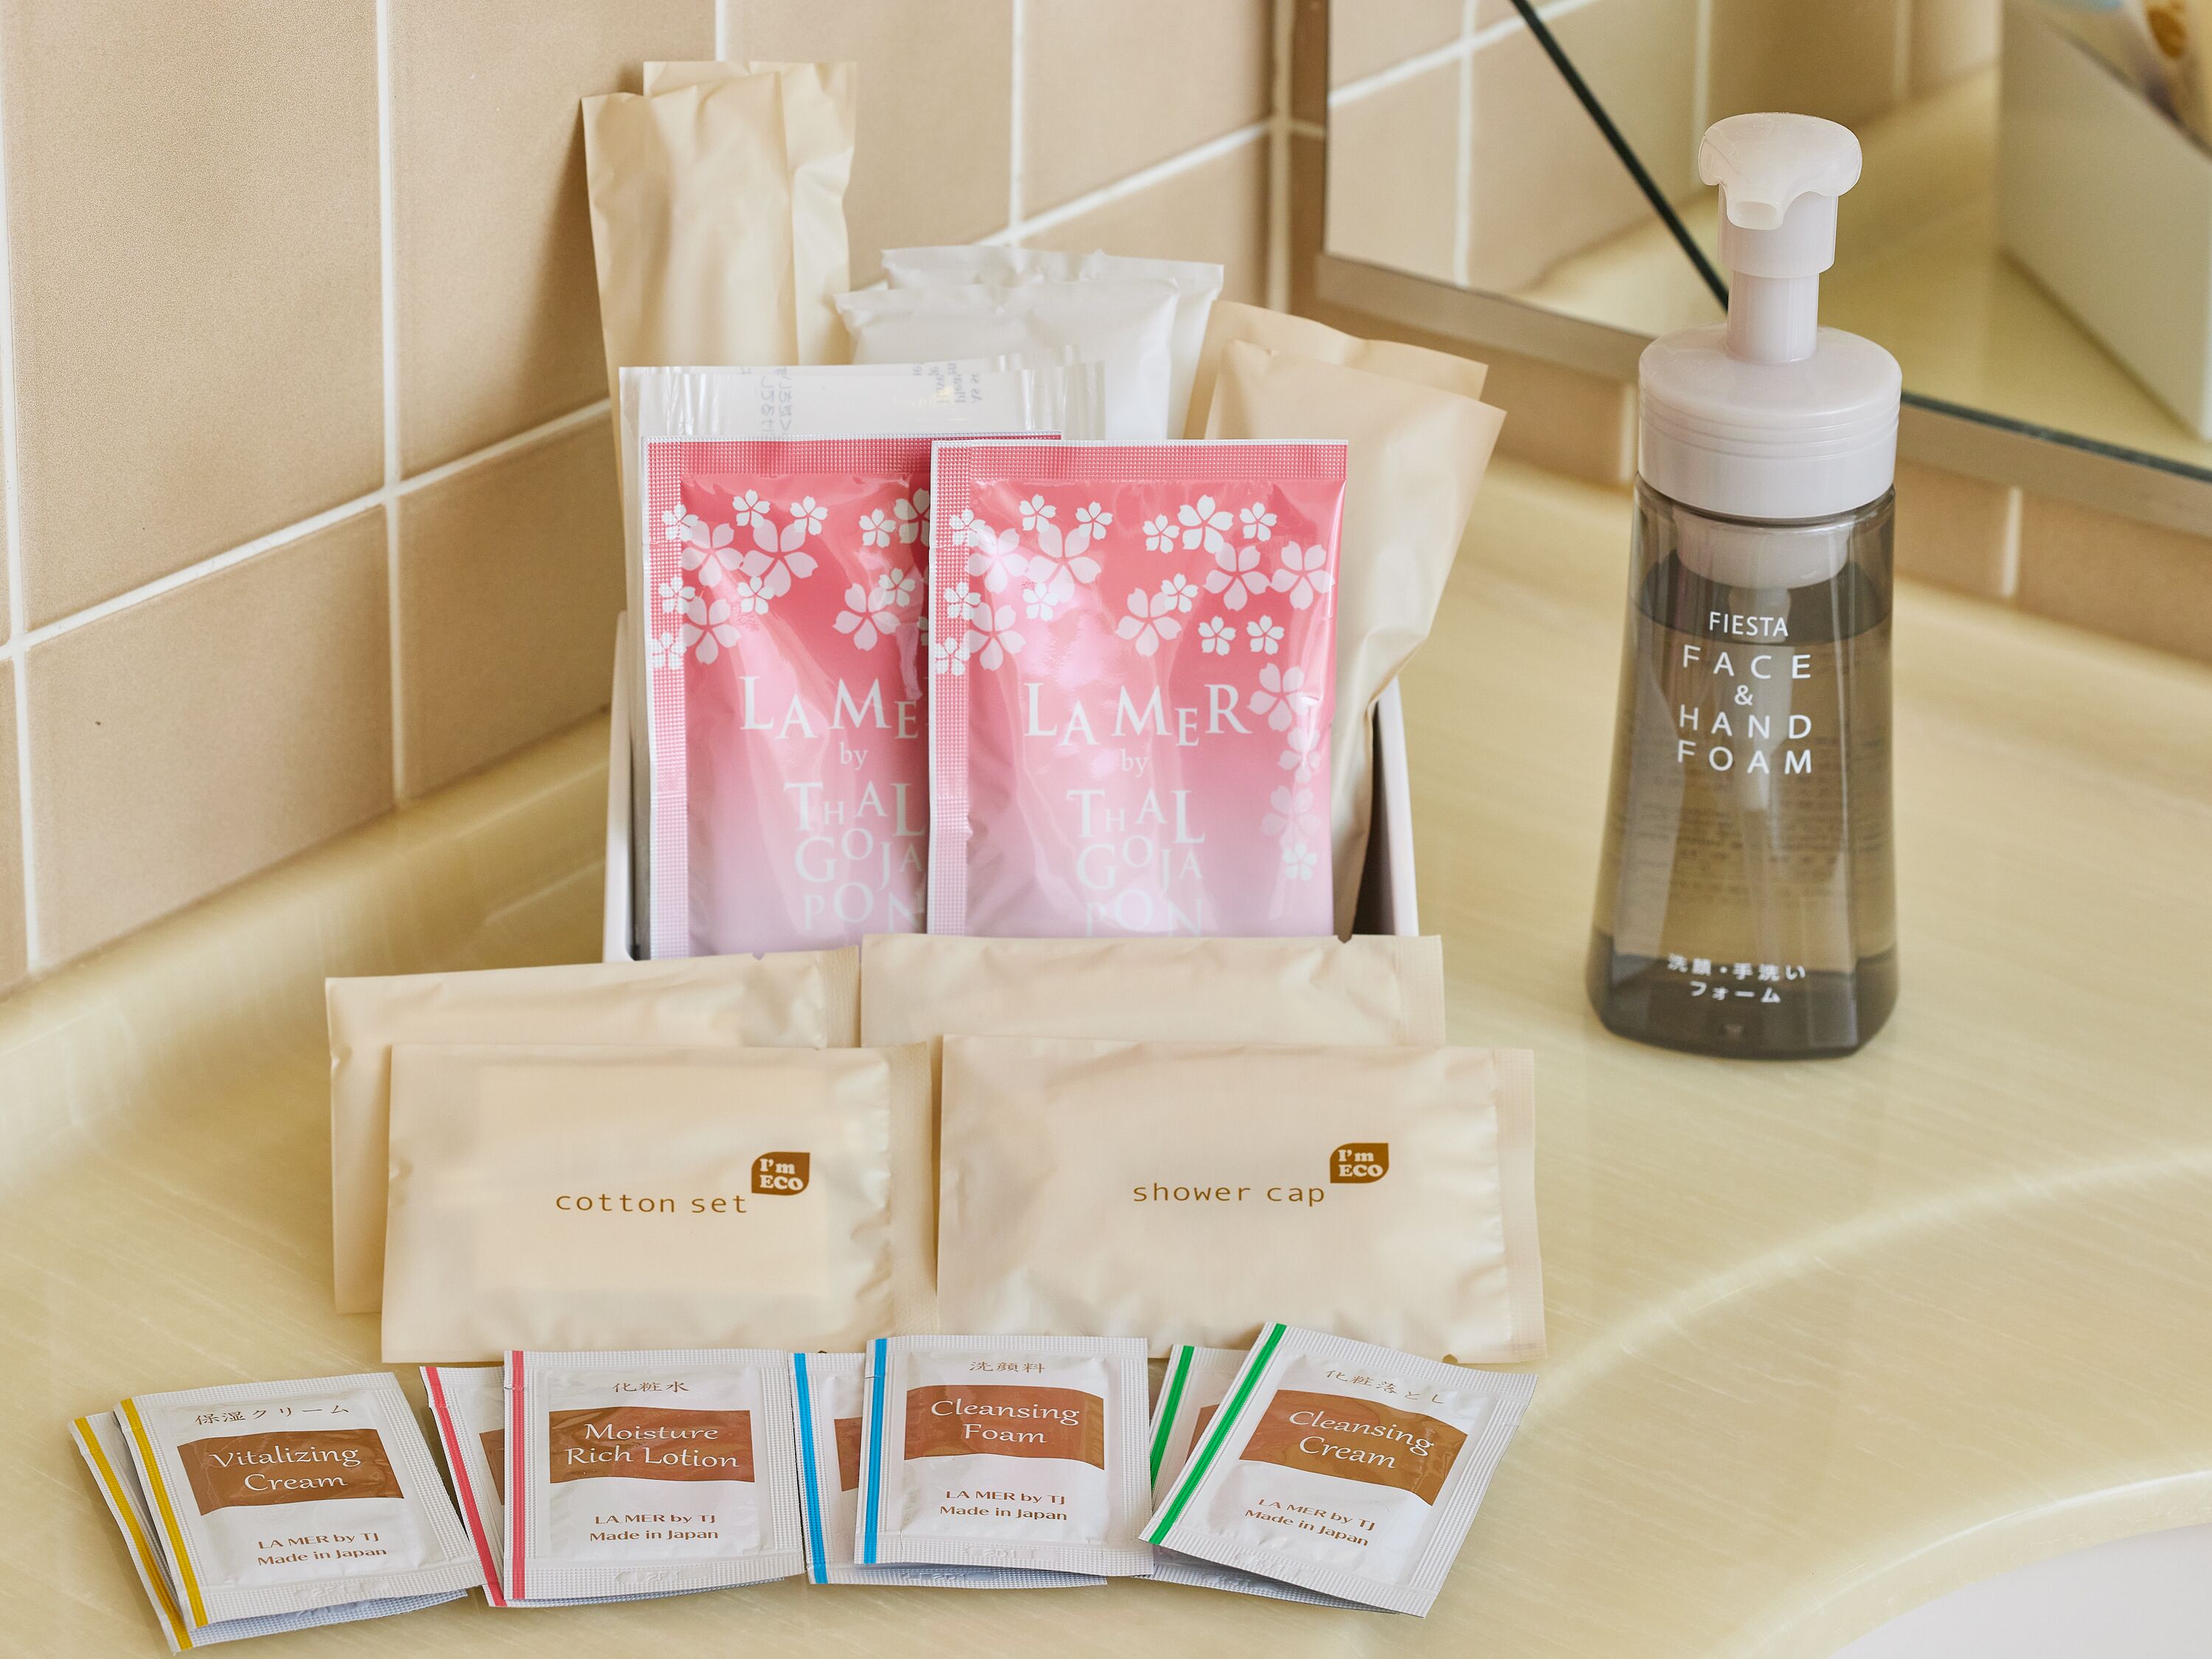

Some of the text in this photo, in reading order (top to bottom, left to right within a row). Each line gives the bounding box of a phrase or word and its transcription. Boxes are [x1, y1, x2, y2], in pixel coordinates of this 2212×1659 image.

[1709, 611, 1789, 637] FIESTA
[1683, 644, 1812, 679] FACE
[1733, 684, 1753, 706] &
[830, 678, 919, 740] ME
[1023, 682, 1253, 747] LA MER
[1679, 704, 1812, 740] HAND
[840, 742, 869, 771] by
[1121, 748, 1150, 778] by
[1677, 739, 1812, 775] FOAM
[1066, 787, 1206, 844] THAL
[1076, 834, 1203, 898] GOJA
[1689, 981, 1781, 1003] フォーム
[759, 1174, 804, 1191] ECO
[1338, 1164, 1384, 1178] ECO
[556, 1193, 748, 1214] cotton set
[1133, 1182, 1326, 1207] shower cap
[970, 1360, 1046, 1374] 洗顔料
[613, 1380, 689, 1394] 化粧水
[1326, 1369, 1445, 1405] 化粧落とし
[195, 1404, 349, 1426] 保湿クリーム
[931, 1399, 1080, 1427] Cleansing
[583, 1422, 719, 1441] Moisture
[961, 1423, 1047, 1444] Foam
[1288, 1411, 1436, 1457] Cleansing
[209, 1444, 361, 1468] Vitalizing
[565, 1446, 740, 1468] Rich Lotion
[1298, 1436, 1397, 1470] Cream
[244, 1472, 348, 1492] Cream
[946, 1490, 1066, 1505] LA MER by TJ
[595, 1514, 716, 1525] LA MER by TJ
[939, 1506, 1068, 1521] Made in Japan
[1259, 1498, 1377, 1532] LA MER by TJ
[589, 1529, 719, 1542] Made in Japan
[1245, 1509, 1369, 1547] Made in Japan
[257, 1532, 380, 1549] LA MER by TJ
[257, 1547, 387, 1567] Made in Japan
